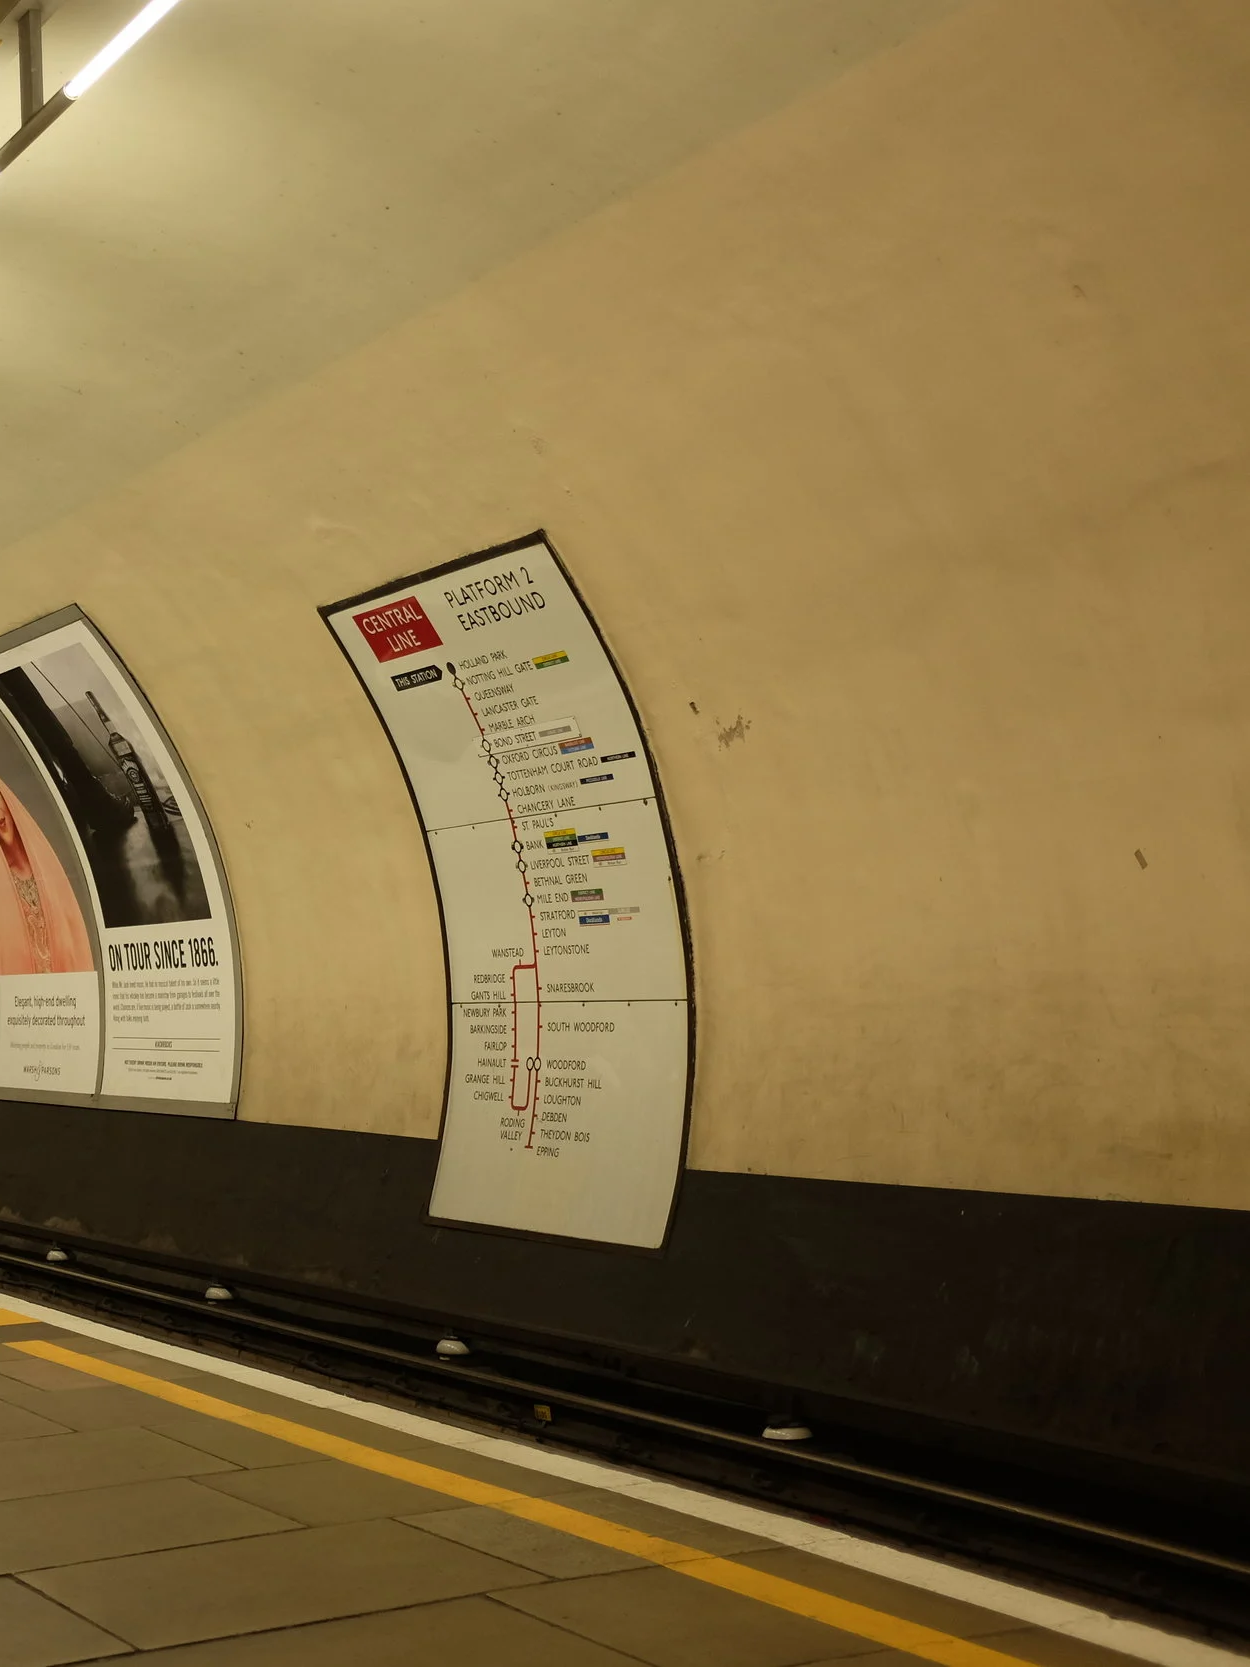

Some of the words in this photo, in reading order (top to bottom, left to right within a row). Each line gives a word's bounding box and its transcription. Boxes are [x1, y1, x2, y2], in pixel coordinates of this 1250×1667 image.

[444, 571, 519, 608] PLATFORM
[520, 566, 534, 584] 2
[457, 591, 545, 632] EASTBOUND
[362, 604, 423, 635] CENTRAL
[387, 630, 421, 653] LINE
[459, 655, 489, 670] HOLLAND
[490, 650, 507, 662] PARK
[466, 671, 497, 685] NOTTING
[499, 667, 513, 678] HILL
[515, 661, 533, 673] GATE
[395, 678, 410, 690] THIS
[411, 669, 437, 685] STATION
[474, 684, 515, 701] QUEENSWAY
[481, 700, 519, 716] LANCASTER
[520, 696, 539, 707] GATE
[489, 719, 515, 732] MARBLE
[516, 715, 535, 727] ARCH
[494, 736, 513, 747] BOND
[515, 731, 536, 743] STREET
[502, 751, 530, 765] OXFORD
[532, 746, 558, 759] CIRCUS
[507, 766, 548, 781] TOTTENHAM
[551, 760, 575, 773] COURT
[578, 756, 598, 768] ROAD
[512, 784, 545, 797] HOLBORN
[548, 781, 579, 793] (KINGSWAY)
[517, 800, 554, 813] CHANCERY
[557, 797, 576, 808] LANE
[533, 817, 554, 829] PAUL'S
[526, 840, 544, 850] BANK
[530, 858, 565, 870] LIVERPOOL
[568, 855, 590, 866] STREET
[534, 876, 563, 887] BETHNAL
[566, 873, 588, 884] GREEN
[537, 893, 552, 904] MILE
[555, 893, 569, 902] END
[540, 909, 575, 921] STRATFORD
[542, 929, 566, 938] LEYTON
[109, 944, 122, 972] ON
[124, 941, 152, 970] TOUR
[155, 939, 187, 969] SINCE
[188, 937, 218, 967] 1866.
[492, 948, 524, 958] WANSTEAD
[544, 944, 590, 956] LEYTONSTONE
[474, 974, 505, 984] REDBRIDGE
[547, 983, 595, 993] SNARESBROOK
[471, 991, 490, 1000] GANTS
[493, 991, 506, 1000] HILL
[15, 995, 33, 1009] Elegant,
[33, 996, 54, 1009] high-end
[55, 995, 77, 1009] dwelling
[463, 1008, 490, 1018] NEWBURY
[493, 1007, 507, 1017] PARK
[7, 1016, 31, 1028] exquisitely
[32, 1015, 57, 1026] decorated
[58, 1016, 85, 1028] throughout
[547, 1022, 570, 1032] SOUTH
[574, 1022, 615, 1033] WOODFORD
[470, 1025, 507, 1034] BARKINGSIDE
[484, 1042, 507, 1051] FAIRLOP
[478, 1058, 506, 1068] HAINAULT
[547, 1060, 586, 1070] WOODFORD
[465, 1074, 490, 1084] GRANGE
[492, 1075, 505, 1084] HILL
[545, 1077, 584, 1088] BUCKHURST
[588, 1079, 602, 1089] HILL
[474, 1091, 504, 1101] CHIGWELL
[544, 1095, 581, 1106] LOUGHTON
[500, 1118, 525, 1128] RODING
[542, 1112, 567, 1123] DEBDEN
[500, 1130, 522, 1140] VALLEY
[540, 1129, 571, 1140] THEYDON
[574, 1131, 590, 1142] BOIS
[537, 1146, 560, 1157] EPPING
